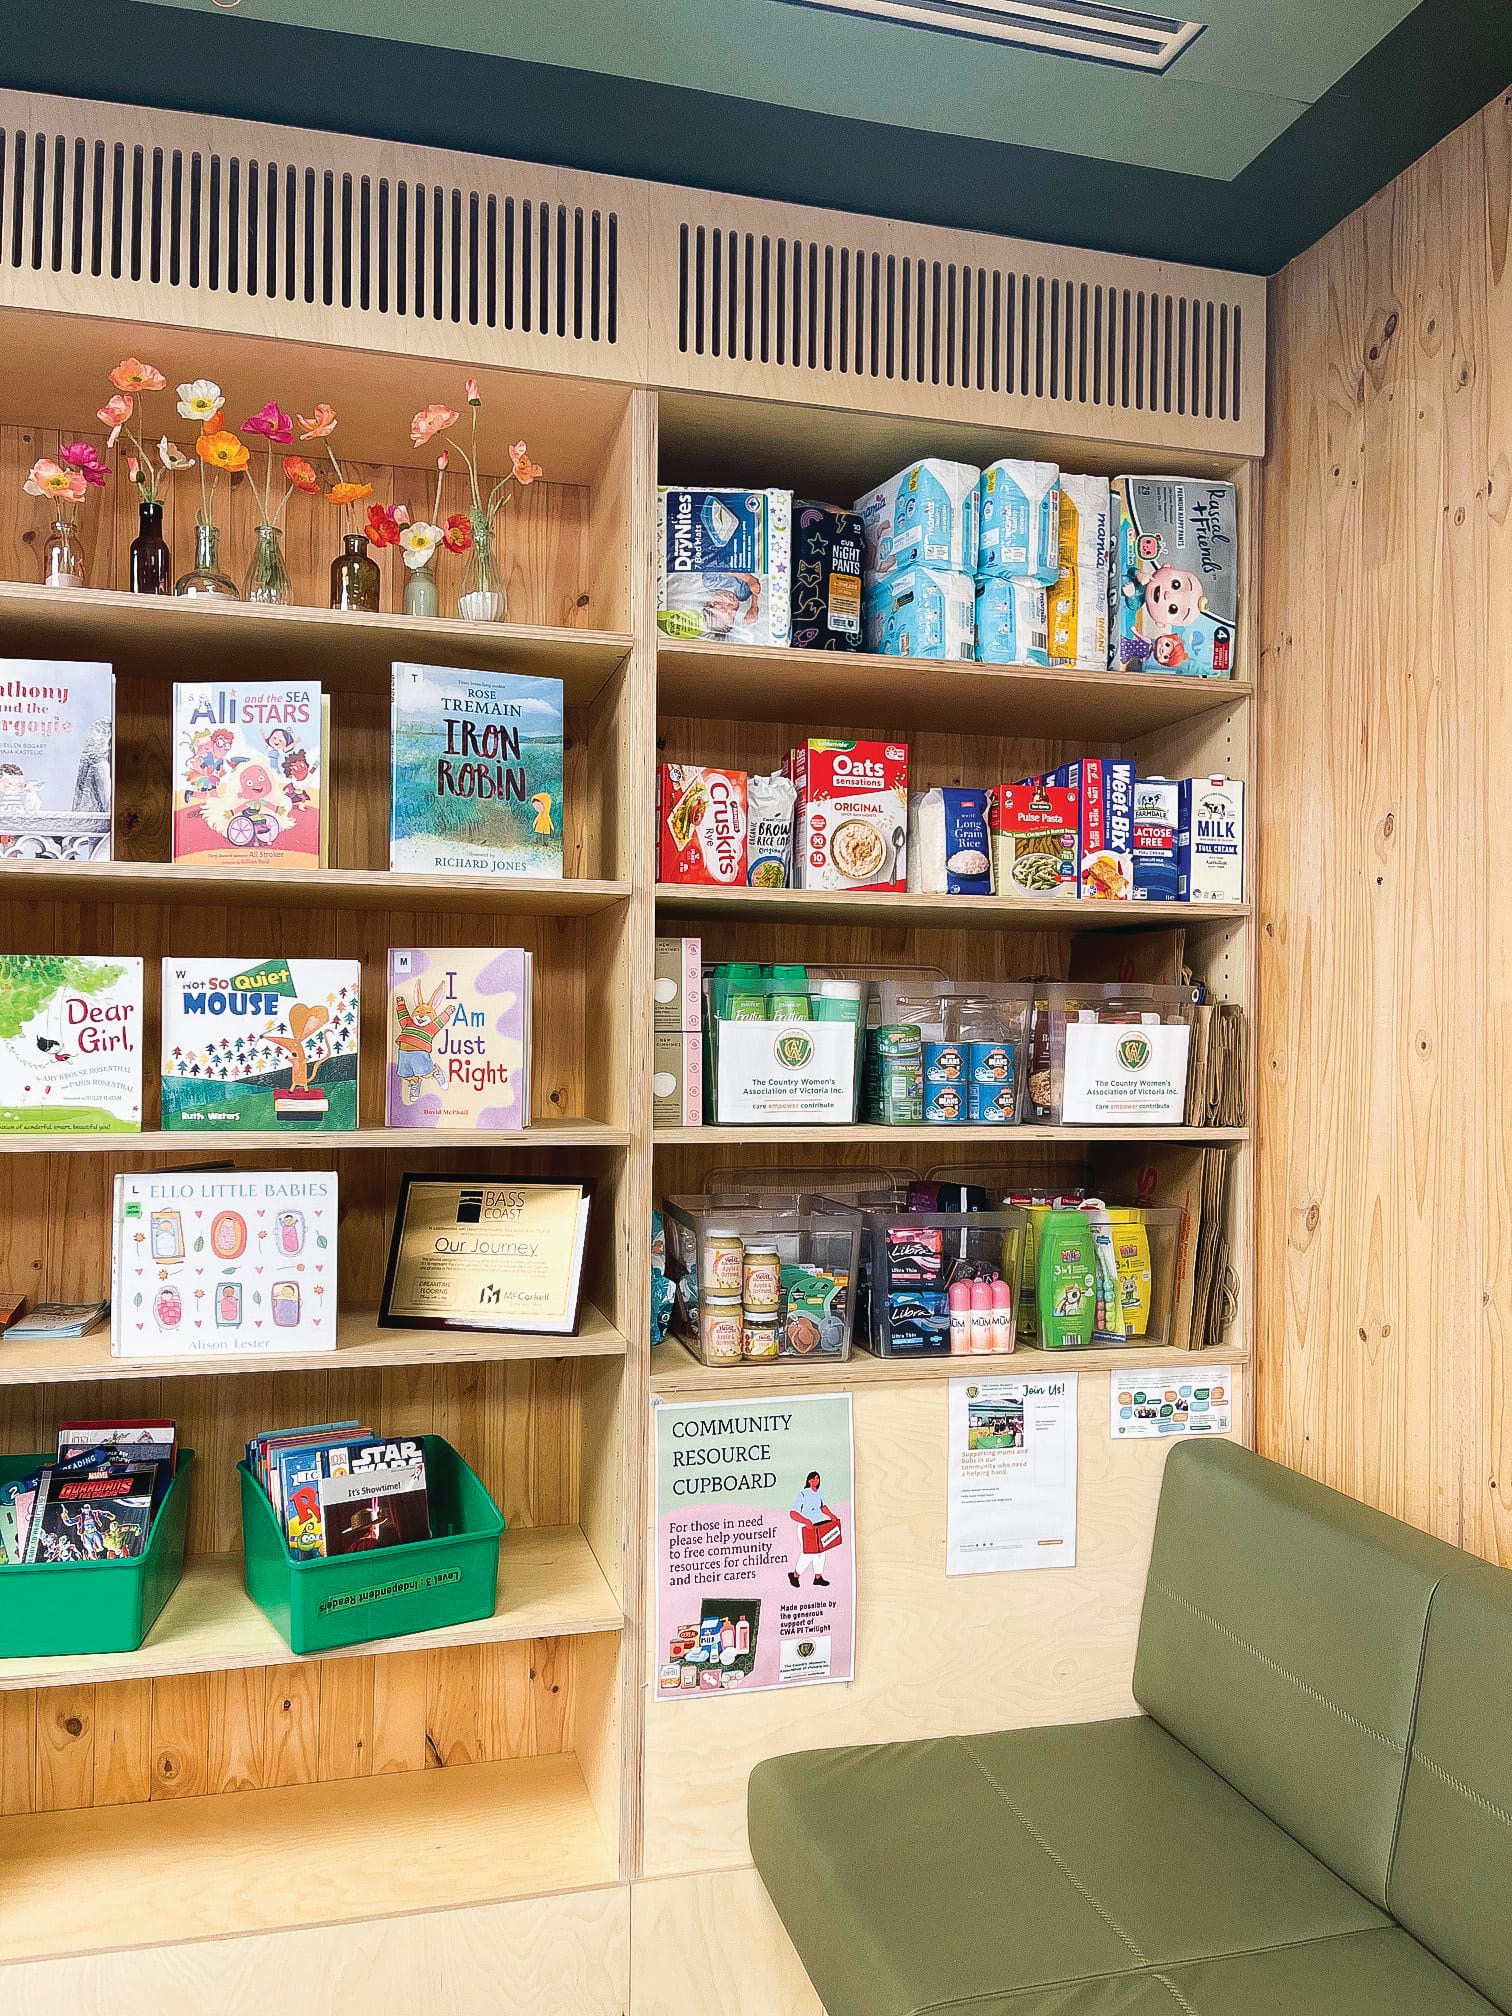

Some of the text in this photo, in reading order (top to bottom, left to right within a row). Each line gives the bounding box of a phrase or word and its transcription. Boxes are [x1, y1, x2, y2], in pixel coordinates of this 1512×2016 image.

[1205, 489, 1230, 544] Rascal
[673, 494, 692, 571] DryNites
[694, 524, 702, 544] Mats
[694, 546, 702, 564] Bed
[832, 558, 860, 574] PANTS
[1096, 512, 1108, 654] mamia INFANT
[1217, 630, 1228, 640] 4
[411, 674, 418, 683] T
[468, 688, 497, 700] ROSE
[27, 703, 49, 713] the
[190, 688, 310, 724] Ali and the SEA
[242, 704, 310, 724] STARS
[441, 698, 522, 717] TREMAIN
[2, 716, 72, 736] rgoyle
[443, 719, 520, 761] IRON
[833, 754, 884, 777] Oats
[836, 778, 882, 787] sensations
[834, 802, 884, 813] ORIGINAL
[1111, 764, 1130, 852] Weet-Bix
[1135, 810, 1168, 818] FARMDALE
[956, 818, 981, 830] Long
[1018, 812, 1063, 823] Pulse Pasta
[710, 782, 736, 874] Cruskits
[954, 829, 983, 838] Grain
[1133, 828, 1172, 838] LACTOSE
[1197, 820, 1235, 838] MILK
[704, 828, 714, 847] Rye
[756, 836, 774, 846] RICE
[812, 837, 823, 845] 90
[958, 838, 981, 848] Rice
[1141, 838, 1163, 847] FREE
[434, 857, 526, 872] RICHARD JONES
[812, 854, 823, 862] 10
[400, 958, 408, 966] M
[176, 971, 186, 979] W
[234, 969, 289, 990] Quiet
[445, 972, 457, 1000] I
[66, 998, 134, 1025] Dear
[183, 992, 279, 1016] MOUSE
[452, 1003, 485, 1027] Am
[77, 1026, 134, 1054] Girl,
[438, 1029, 486, 1055] Just
[941, 1057, 960, 1065] BEANS
[43, 1065, 132, 1082] AMY KROUSE ROSENTHAL
[448, 1059, 508, 1091] Right
[69, 1080, 134, 1093] PARIS ROSENTHAL
[1111, 1080, 1137, 1088] Country
[181, 1112, 241, 1120] Ruth Waters
[150, 1183, 328, 1198] ELLO LITTLE BABIES
[484, 1191, 526, 1208] BASS
[484, 1208, 522, 1219] COAST
[434, 1238, 538, 1257] Our Journey
[892, 1245, 929, 1256] Libra
[892, 1308, 928, 1319] Libra
[188, 1339, 271, 1350] Alison Lester
[1022, 1384, 1045, 1396] Join
[1048, 1383, 1065, 1396] Us!
[672, 1414, 793, 1438] COMMUNITY
[331, 1442, 423, 1466] DK STAR
[672, 1444, 771, 1467] RESOURCE
[962, 1450, 995, 1458] Supporting
[88, 1472, 109, 1480] MARVEL
[672, 1472, 777, 1496] CUPBOARD
[9, 1486, 19, 1499] 2
[59, 1478, 134, 1498] GUARDIANS
[348, 1482, 401, 1497] It's Showtime!
[669, 1516, 764, 1534] For those in need
[669, 1527, 776, 1550] please help yourself
[669, 1542, 772, 1559] to free community
[669, 1553, 788, 1572] resources for children
[669, 1569, 756, 1586] and their carers
[319, 1571, 459, 1612] Level 3 Independent Readers
[800, 1601, 826, 1611] possible
[828, 1600, 836, 1608] by
[793, 1610, 823, 1620] generous
[780, 1619, 805, 1628] support
[805, 1624, 830, 1633] Twilight
